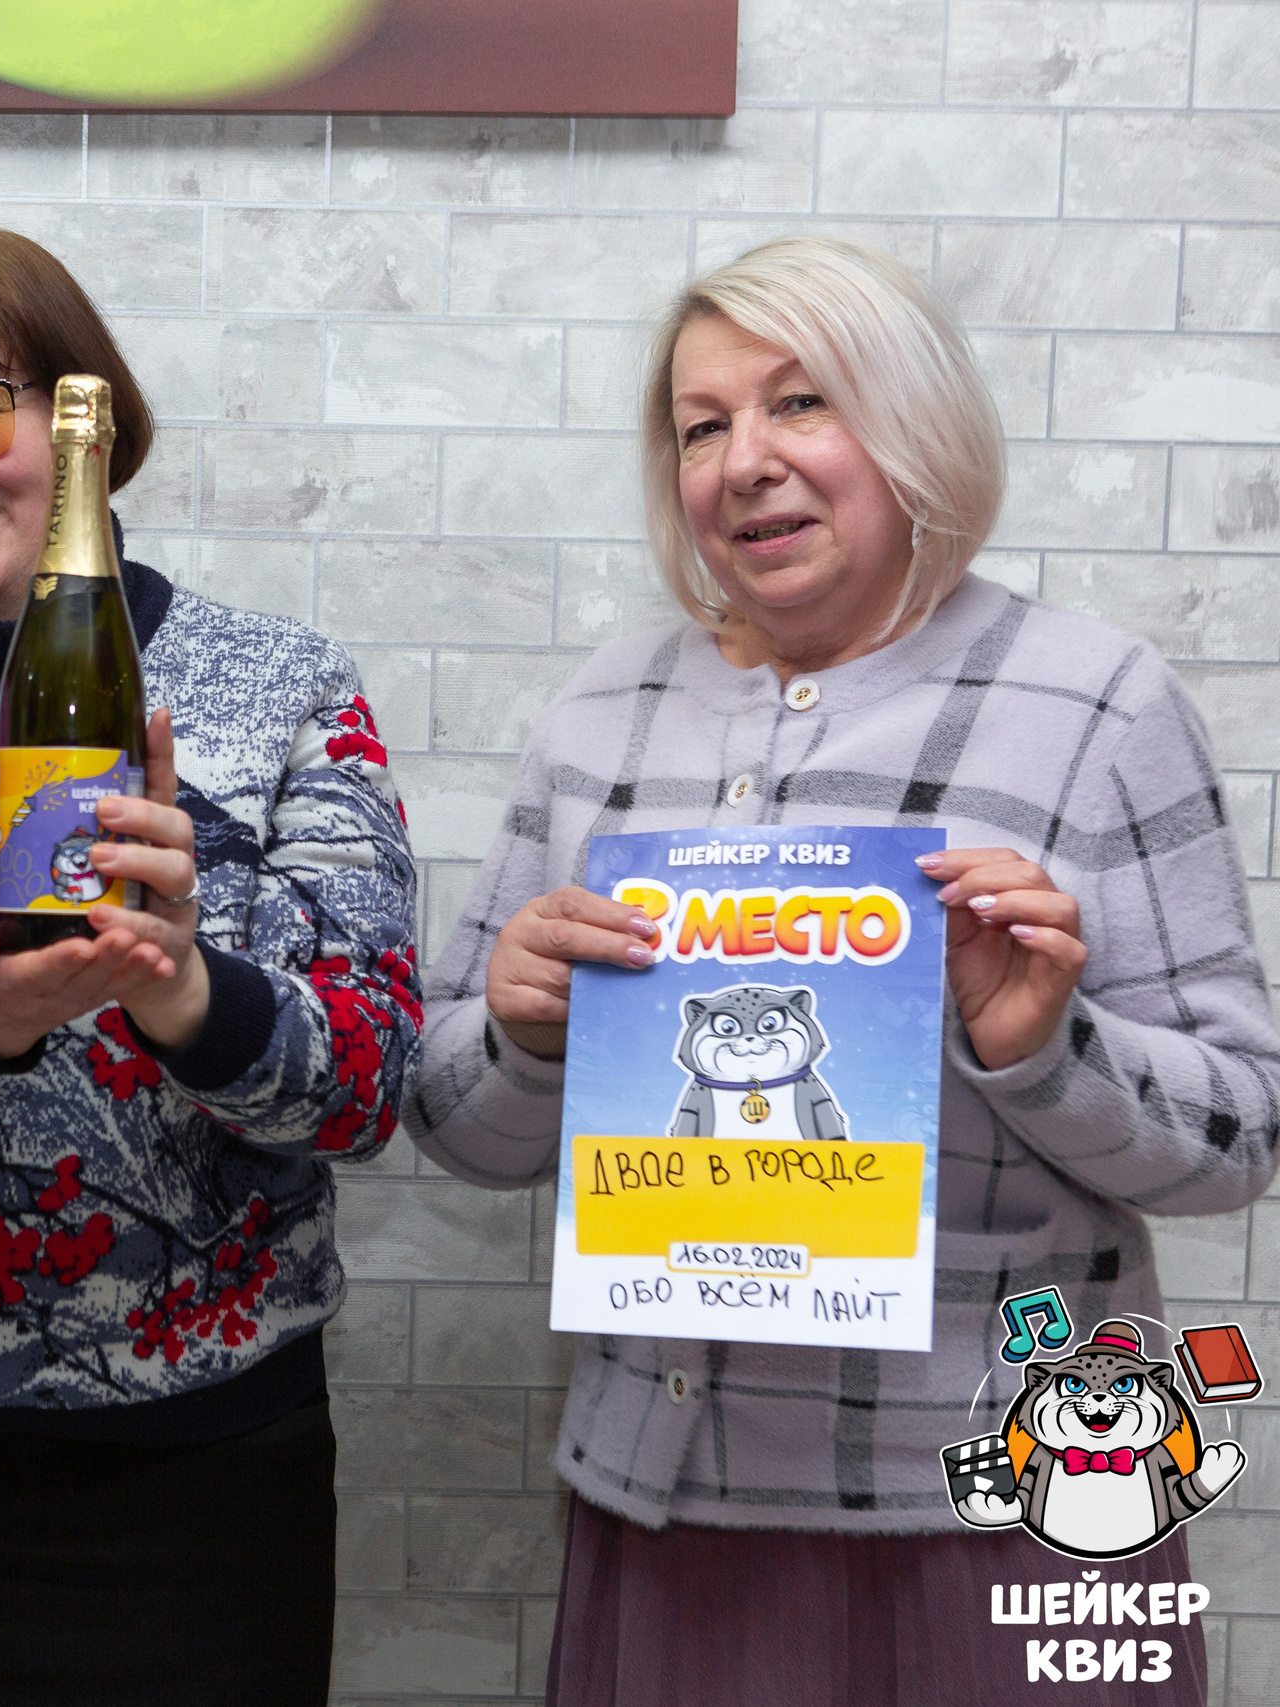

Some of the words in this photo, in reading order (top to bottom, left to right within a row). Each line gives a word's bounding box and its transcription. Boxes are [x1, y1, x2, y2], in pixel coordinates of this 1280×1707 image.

[46, 454, 68, 550] TARINO
[667, 840, 770, 866] ШЕЙКЕР
[778, 843, 852, 866] КВИЗ
[676, 894, 902, 957] МЕСТО
[609, 1277, 673, 1311] ОБО
